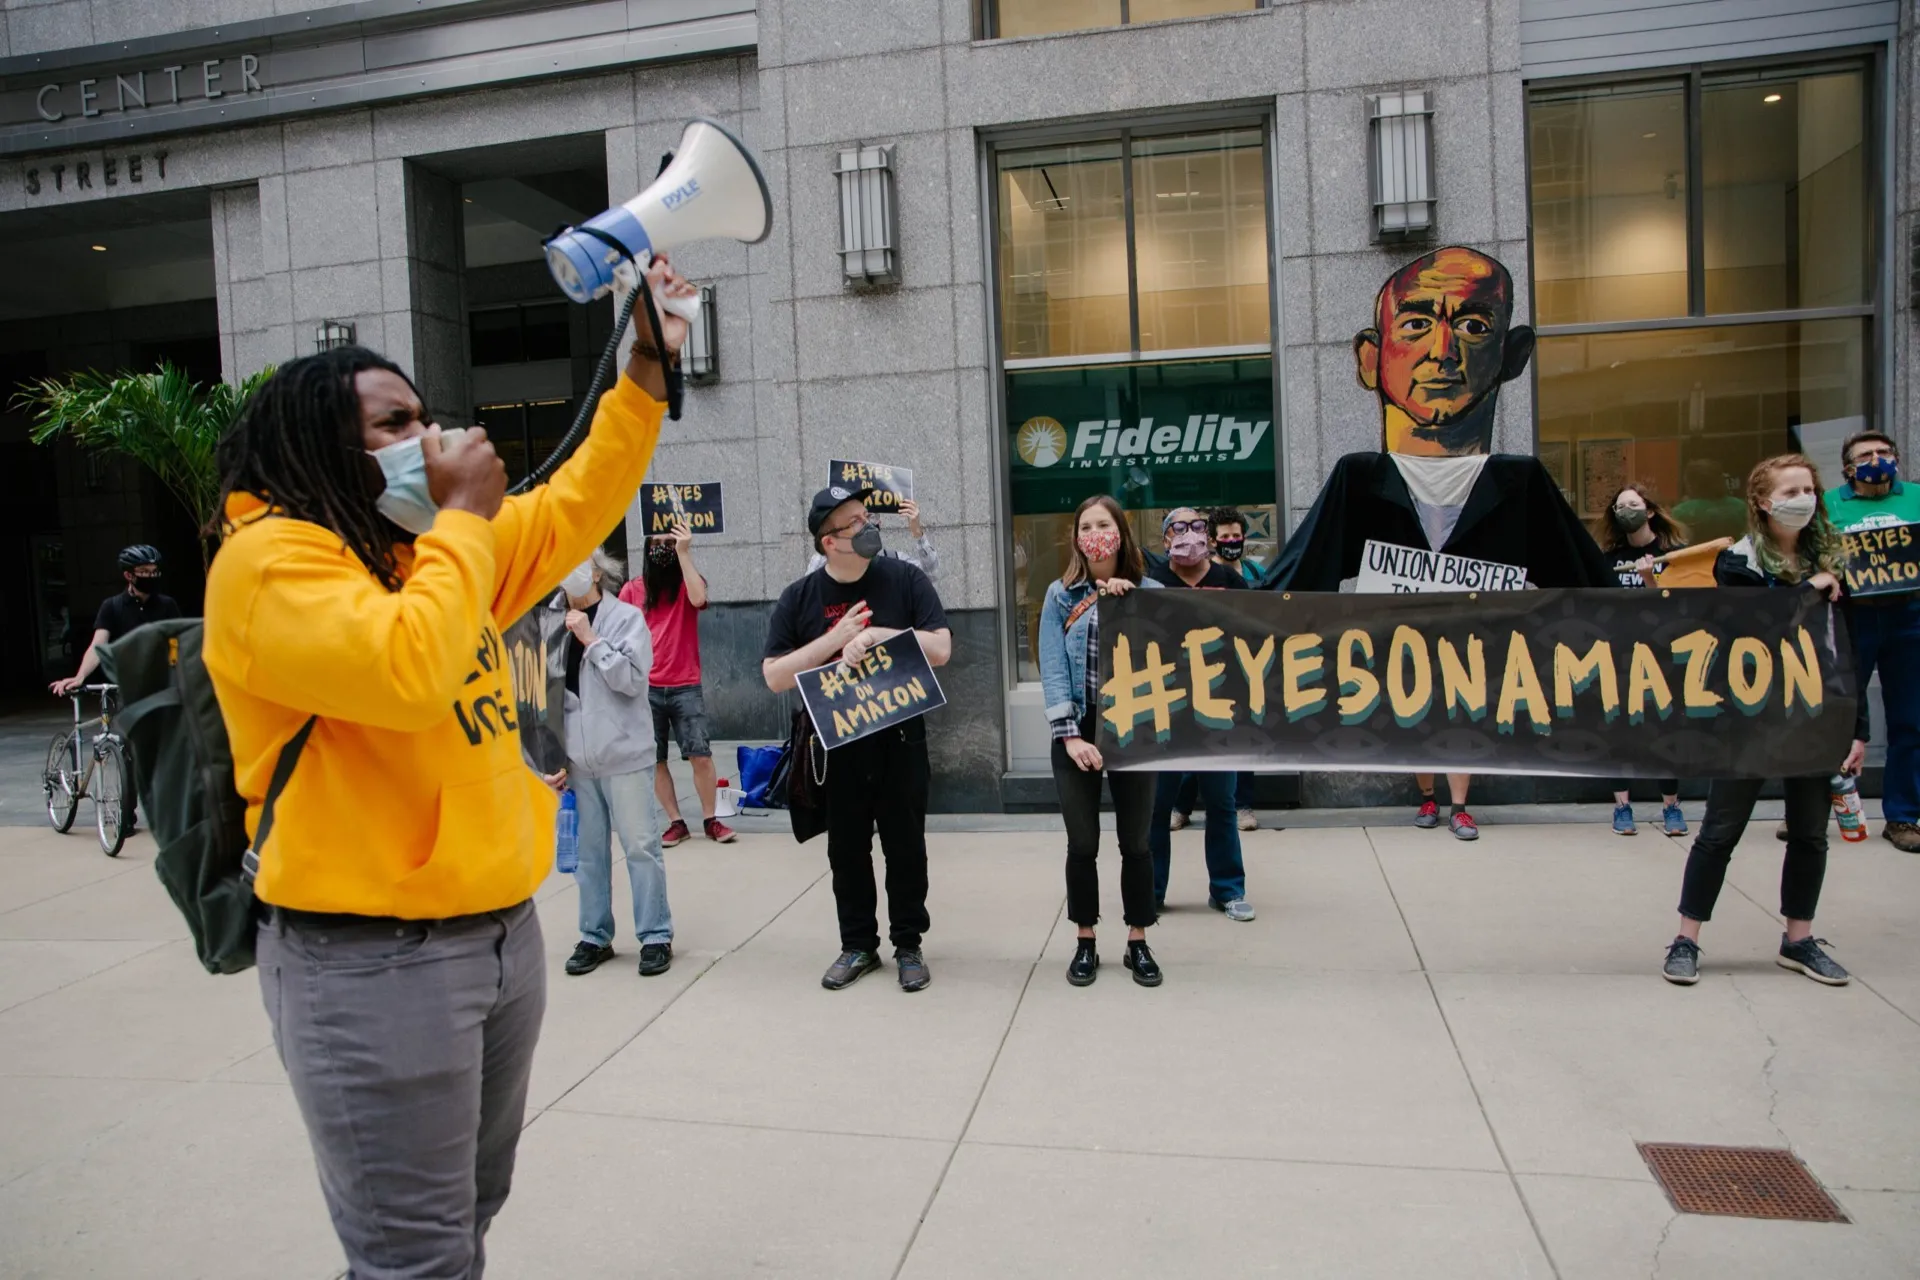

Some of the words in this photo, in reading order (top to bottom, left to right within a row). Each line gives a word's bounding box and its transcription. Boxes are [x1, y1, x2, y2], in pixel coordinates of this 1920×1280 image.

[36, 54, 263, 121] CENTER
[26, 150, 169, 196] STREET
[661, 178, 701, 209] PYLE
[1071, 414, 1270, 460] Fidelity
[842, 463, 892, 482] #EYES
[1069, 453, 1228, 469] INVESTMENTS
[652, 484, 703, 505] #EYES
[861, 480, 873, 490] ON
[863, 489, 904, 508] AZON
[652, 510, 715, 532] AMAZON
[1841, 526, 1912, 558] #EYES
[1369, 542, 1440, 582] UNION
[1441, 556, 1523, 591] BUSTER-
[1870, 553, 1887, 567] ON
[1845, 561, 1920, 591] MAZO
[819, 645, 893, 700] #EYES
[1100, 625, 1823, 748] #EYESONAMAZON
[832, 676, 928, 739] AMAZON
[855, 683, 876, 701] ON
[453, 689, 518, 746] VOE
